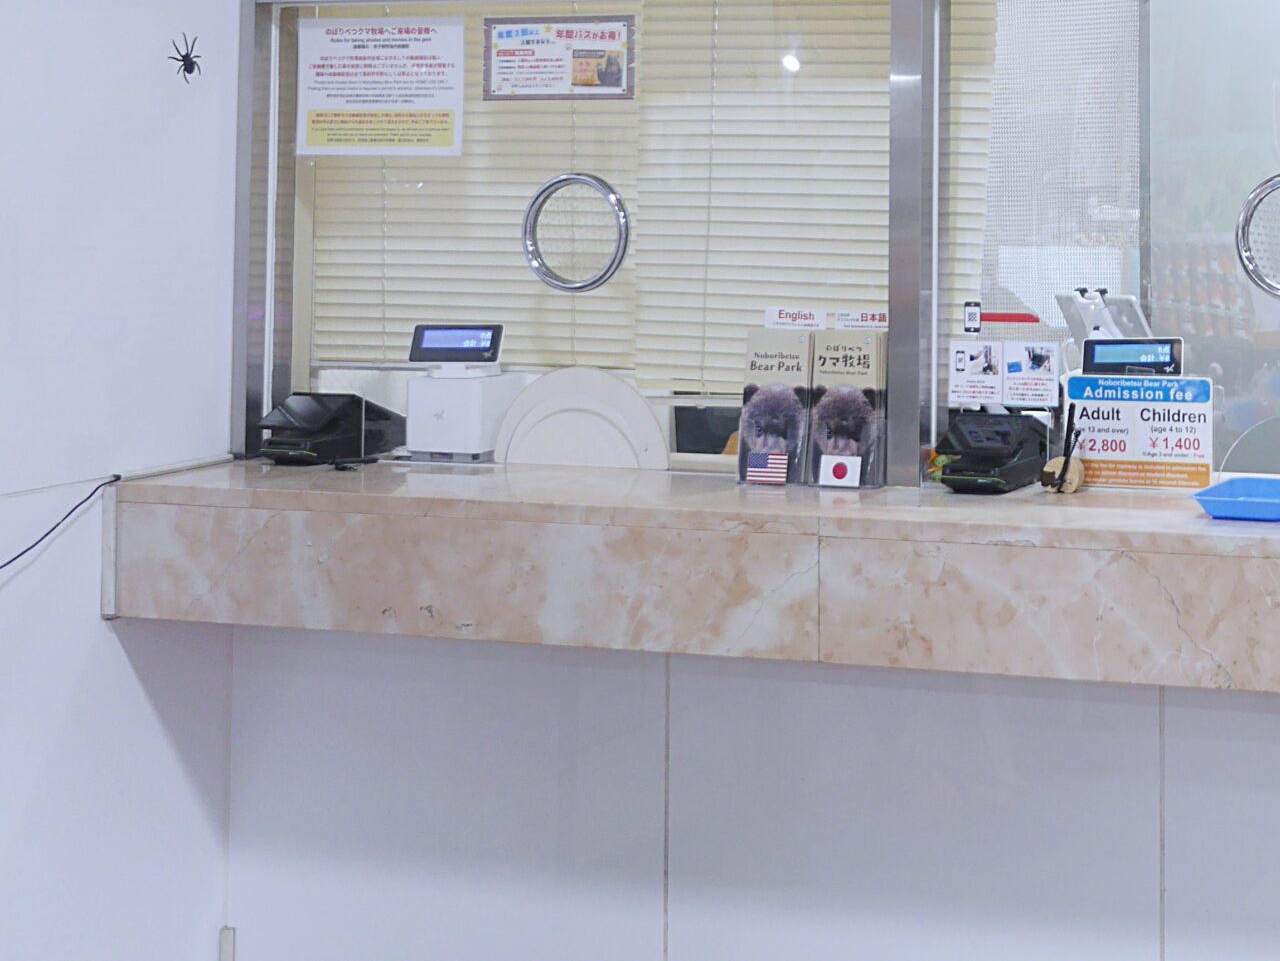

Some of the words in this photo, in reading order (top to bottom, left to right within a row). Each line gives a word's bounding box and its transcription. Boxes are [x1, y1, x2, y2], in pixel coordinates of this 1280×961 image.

[778, 309, 815, 322] English
[860, 312, 887, 323] 日本語
[750, 361, 775, 372] Bear
[777, 361, 803, 372] Park
[818, 353, 871, 369] クマ牧場
[1098, 379, 1141, 387] Noboribetsu
[1161, 380, 1178, 388] Park
[1083, 386, 1164, 400] Admission
[1169, 388, 1193, 401] fee
[1079, 406, 1121, 421] Adult
[1140, 407, 1207, 424] Children
[1097, 425, 1110, 433] and
[1151, 425, 1167, 434] (age
